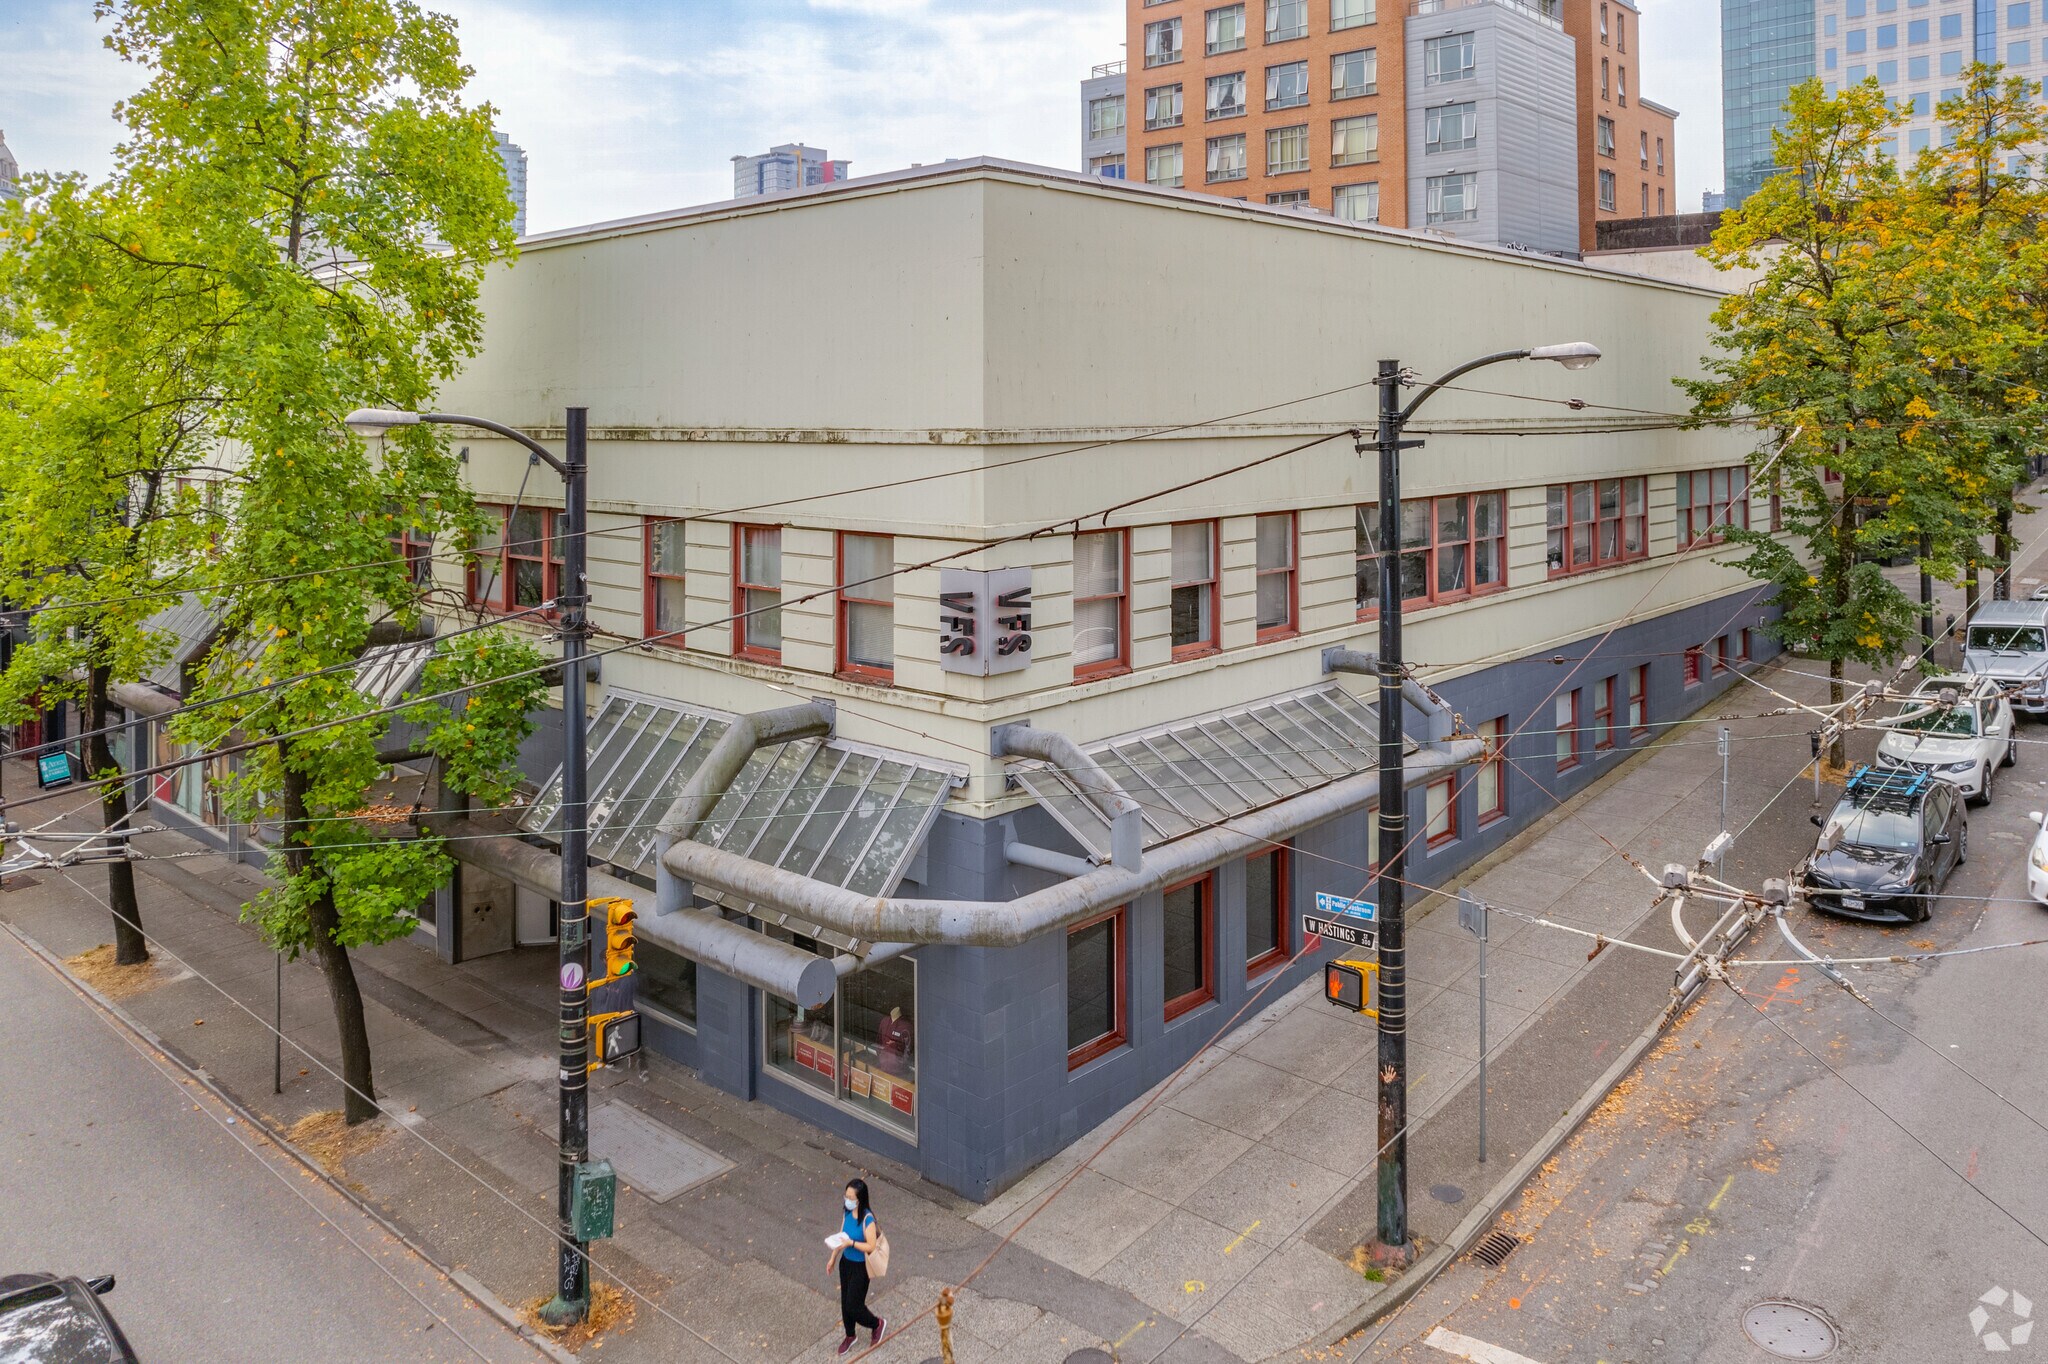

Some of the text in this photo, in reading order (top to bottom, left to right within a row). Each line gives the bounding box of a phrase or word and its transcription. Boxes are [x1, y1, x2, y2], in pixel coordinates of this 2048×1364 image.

[940, 591, 975, 657] VFS
[998, 587, 1032, 656] VFS
[1308, 919, 1356, 942] W HASTINGS
[1361, 938, 1371, 946] 300
